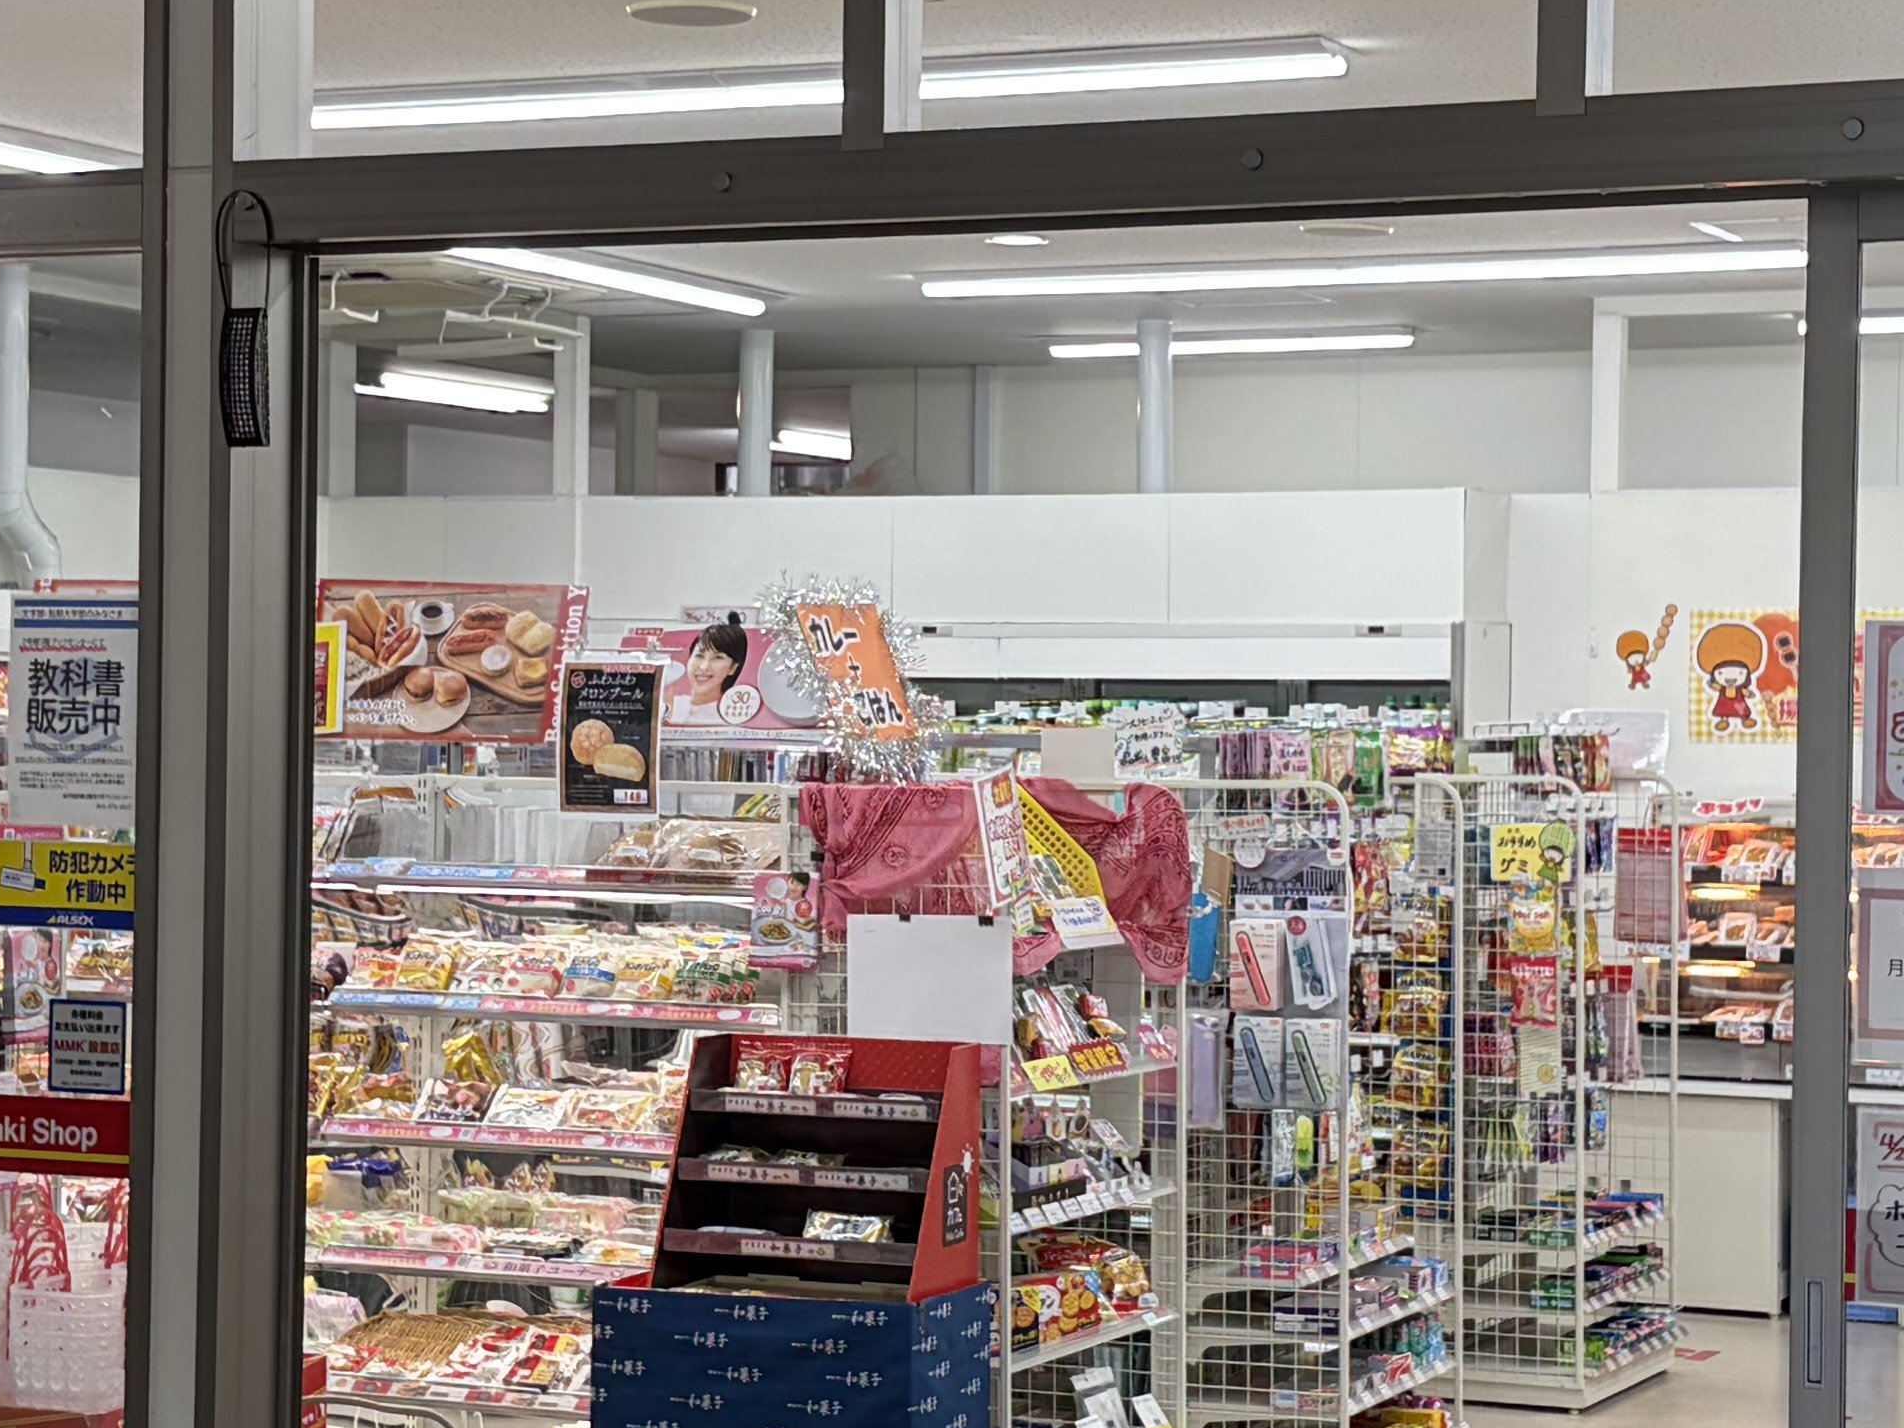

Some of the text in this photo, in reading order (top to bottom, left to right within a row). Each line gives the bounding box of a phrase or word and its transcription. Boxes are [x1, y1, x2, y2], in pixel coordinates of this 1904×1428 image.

[809, 614, 860, 656] カレー
[28, 658, 125, 697] 教科書
[732, 691, 750, 705] 30
[26, 698, 121, 736] 販売中
[1499, 856, 1530, 874] グミ
[66, 880, 126, 904] 作動中
[54, 1039, 84, 1052] MMK
[32, 1117, 98, 1153] Shop
